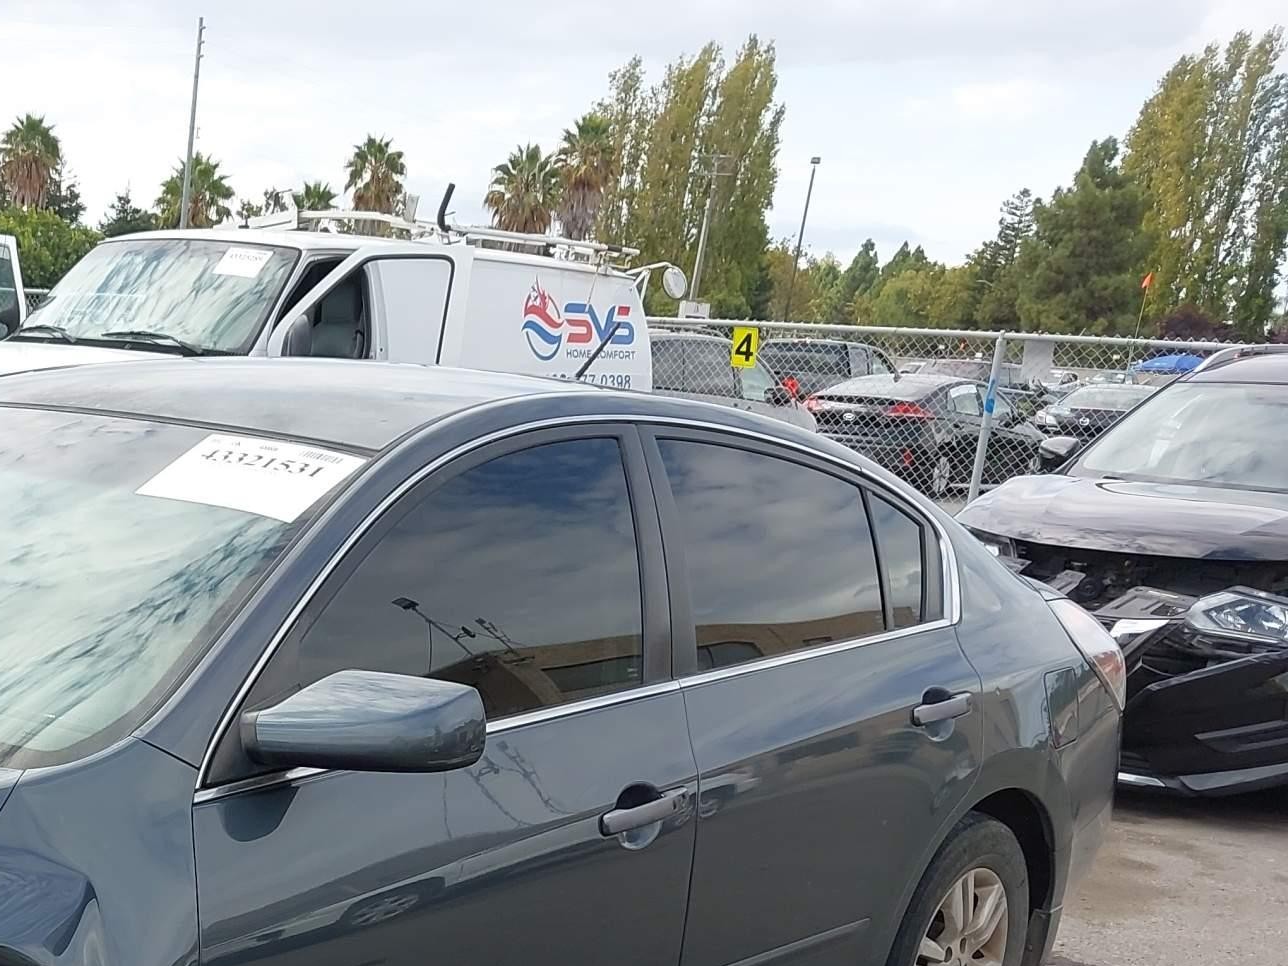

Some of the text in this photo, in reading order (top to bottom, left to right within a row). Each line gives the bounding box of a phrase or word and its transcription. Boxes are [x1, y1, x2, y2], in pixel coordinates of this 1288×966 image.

[564, 303, 635, 345] SVS
[566, 349, 592, 359] HOME
[734, 333, 753, 362] 4
[201, 449, 324, 477] 43321531
